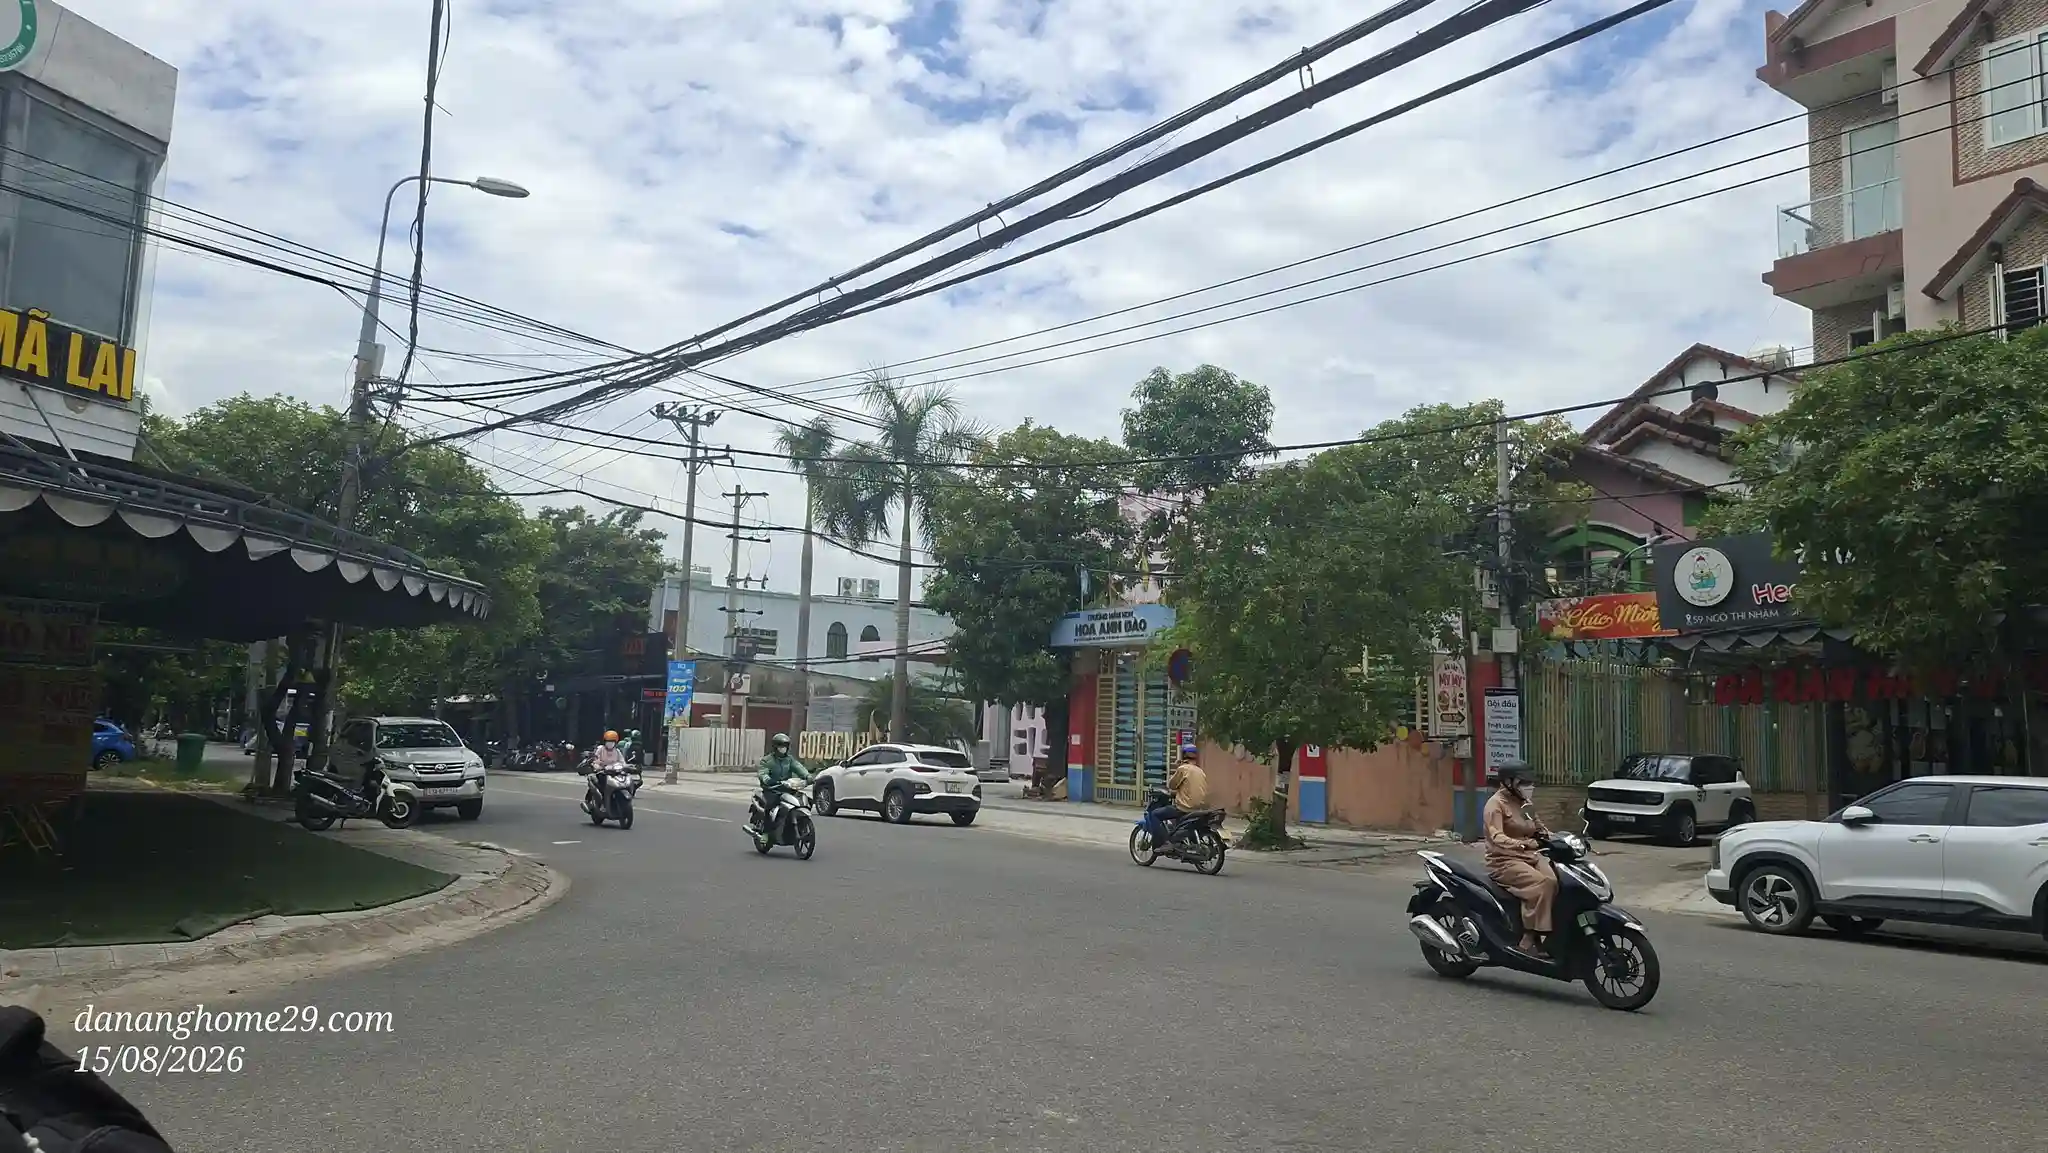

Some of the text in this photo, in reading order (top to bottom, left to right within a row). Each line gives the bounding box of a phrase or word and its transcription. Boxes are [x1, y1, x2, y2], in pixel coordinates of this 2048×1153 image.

[66, 331, 134, 400] LAI
[1074, 622, 1096, 637] HOA
[1100, 619, 1122, 635] ANH
[799, 730, 853, 760] GOLDEN
